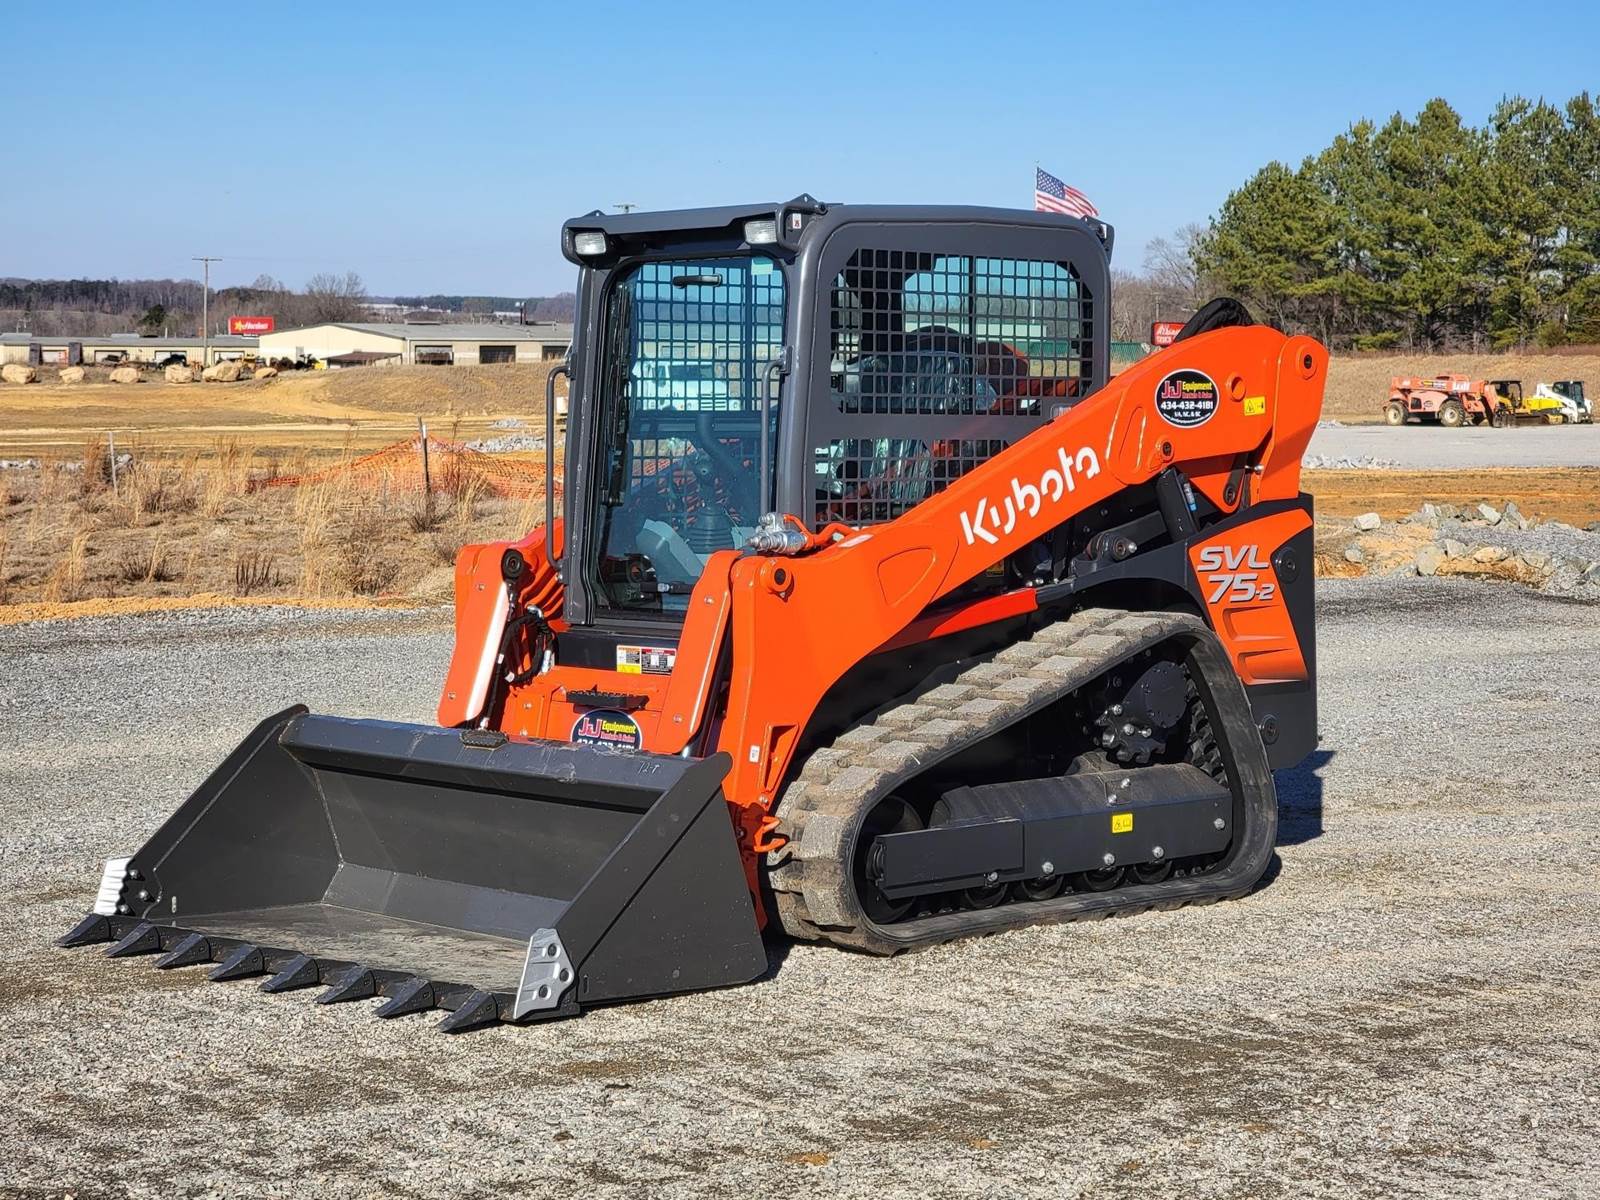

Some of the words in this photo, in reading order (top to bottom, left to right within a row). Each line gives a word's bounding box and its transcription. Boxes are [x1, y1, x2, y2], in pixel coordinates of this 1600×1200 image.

[1182, 381, 1213, 392] Equipment
[1160, 401, 1213, 410] 434-432-4181
[959, 446, 1101, 546] Kubota
[1197, 544, 1270, 572] SVL
[1208, 573, 1276, 604] 75-2
[602, 720, 637, 734] Equipment
